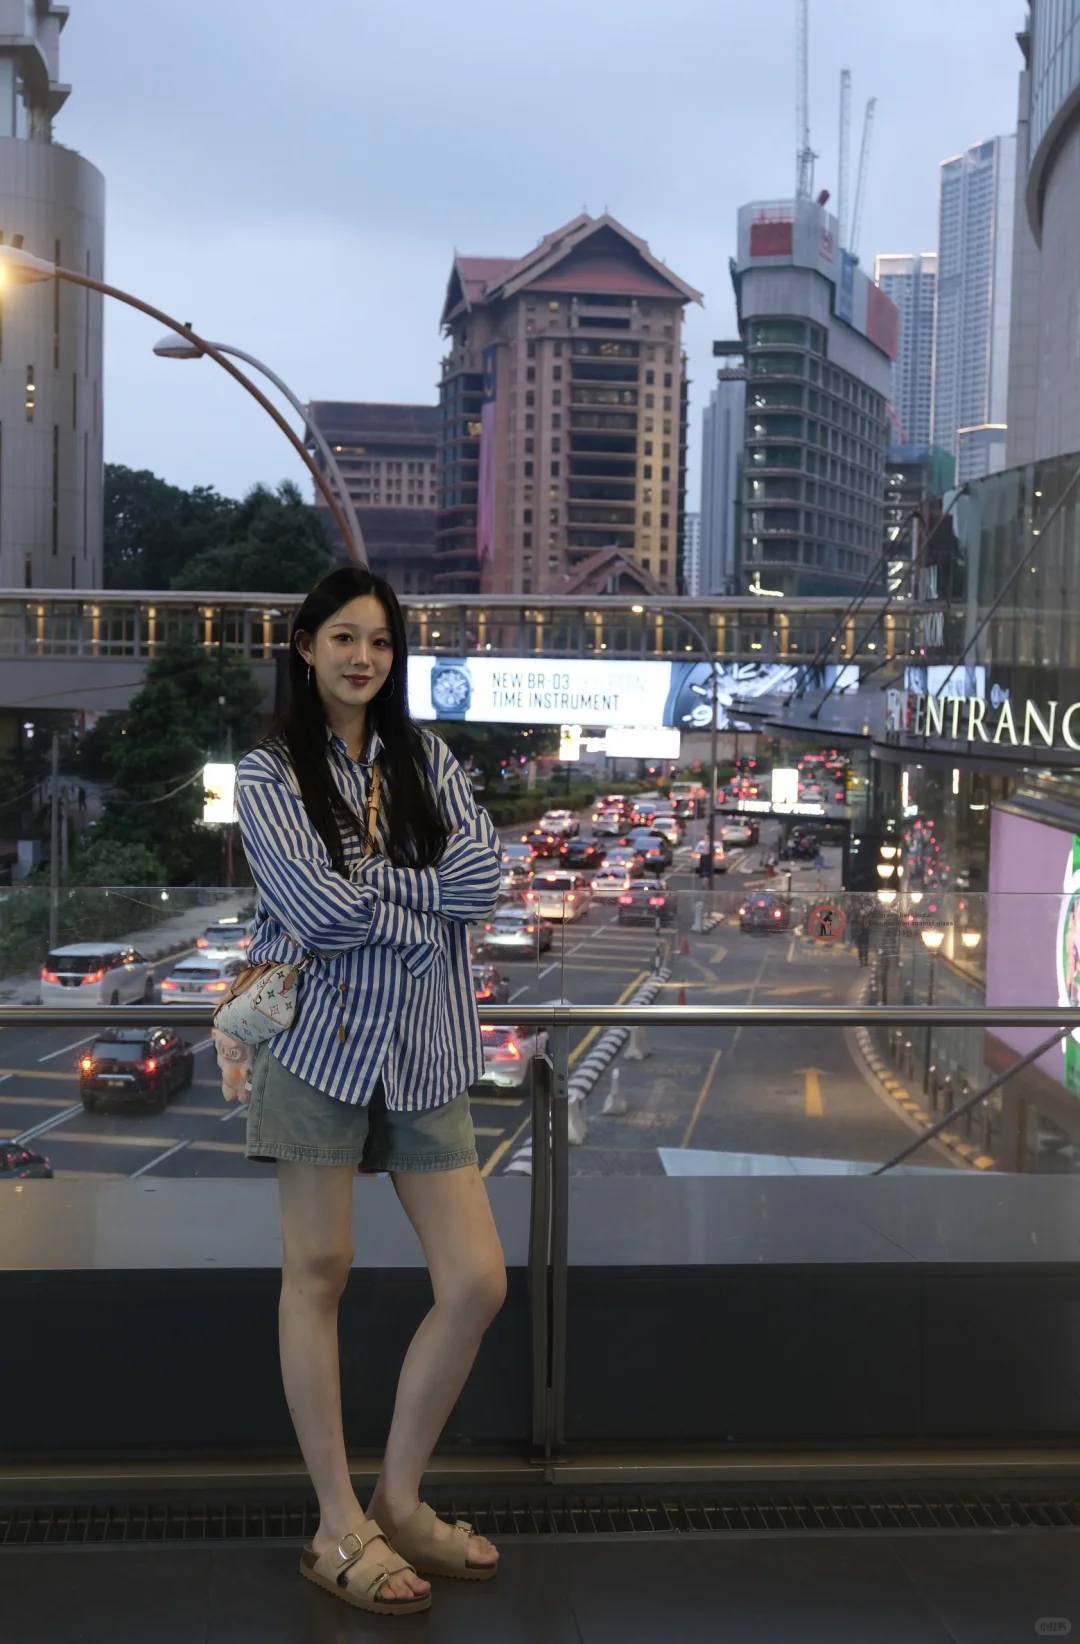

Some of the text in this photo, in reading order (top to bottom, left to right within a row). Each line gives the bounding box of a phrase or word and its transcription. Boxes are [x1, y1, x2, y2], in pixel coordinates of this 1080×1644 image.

[492, 672, 523, 689] NEW
[528, 673, 570, 690] BR-03
[492, 691, 620, 711] TIME INSTRUMENT
[936, 920, 953, 928] glass
